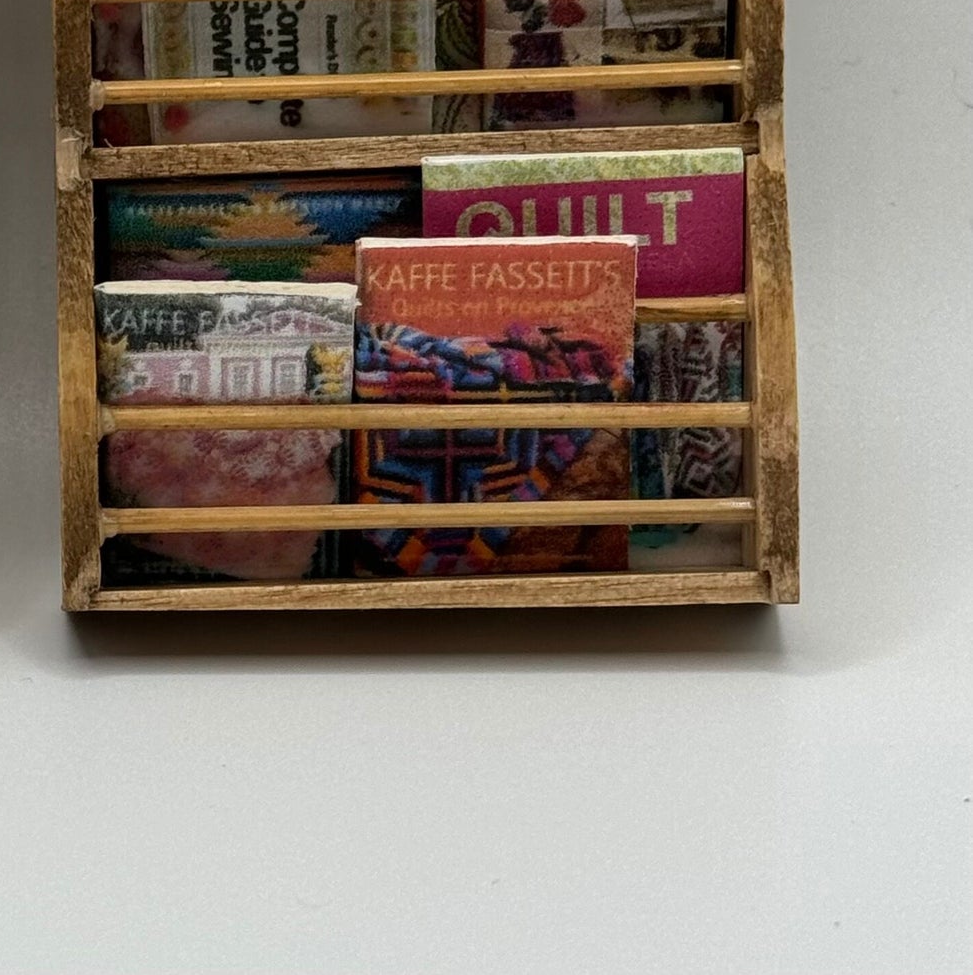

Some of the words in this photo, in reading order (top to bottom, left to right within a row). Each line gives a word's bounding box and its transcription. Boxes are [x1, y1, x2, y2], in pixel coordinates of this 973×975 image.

[455, 189, 693, 247] QUILT
[366, 263, 457, 291] KAFFE
[470, 259, 620, 290] FASSETT'S
[102, 309, 188, 336] KAFFE
